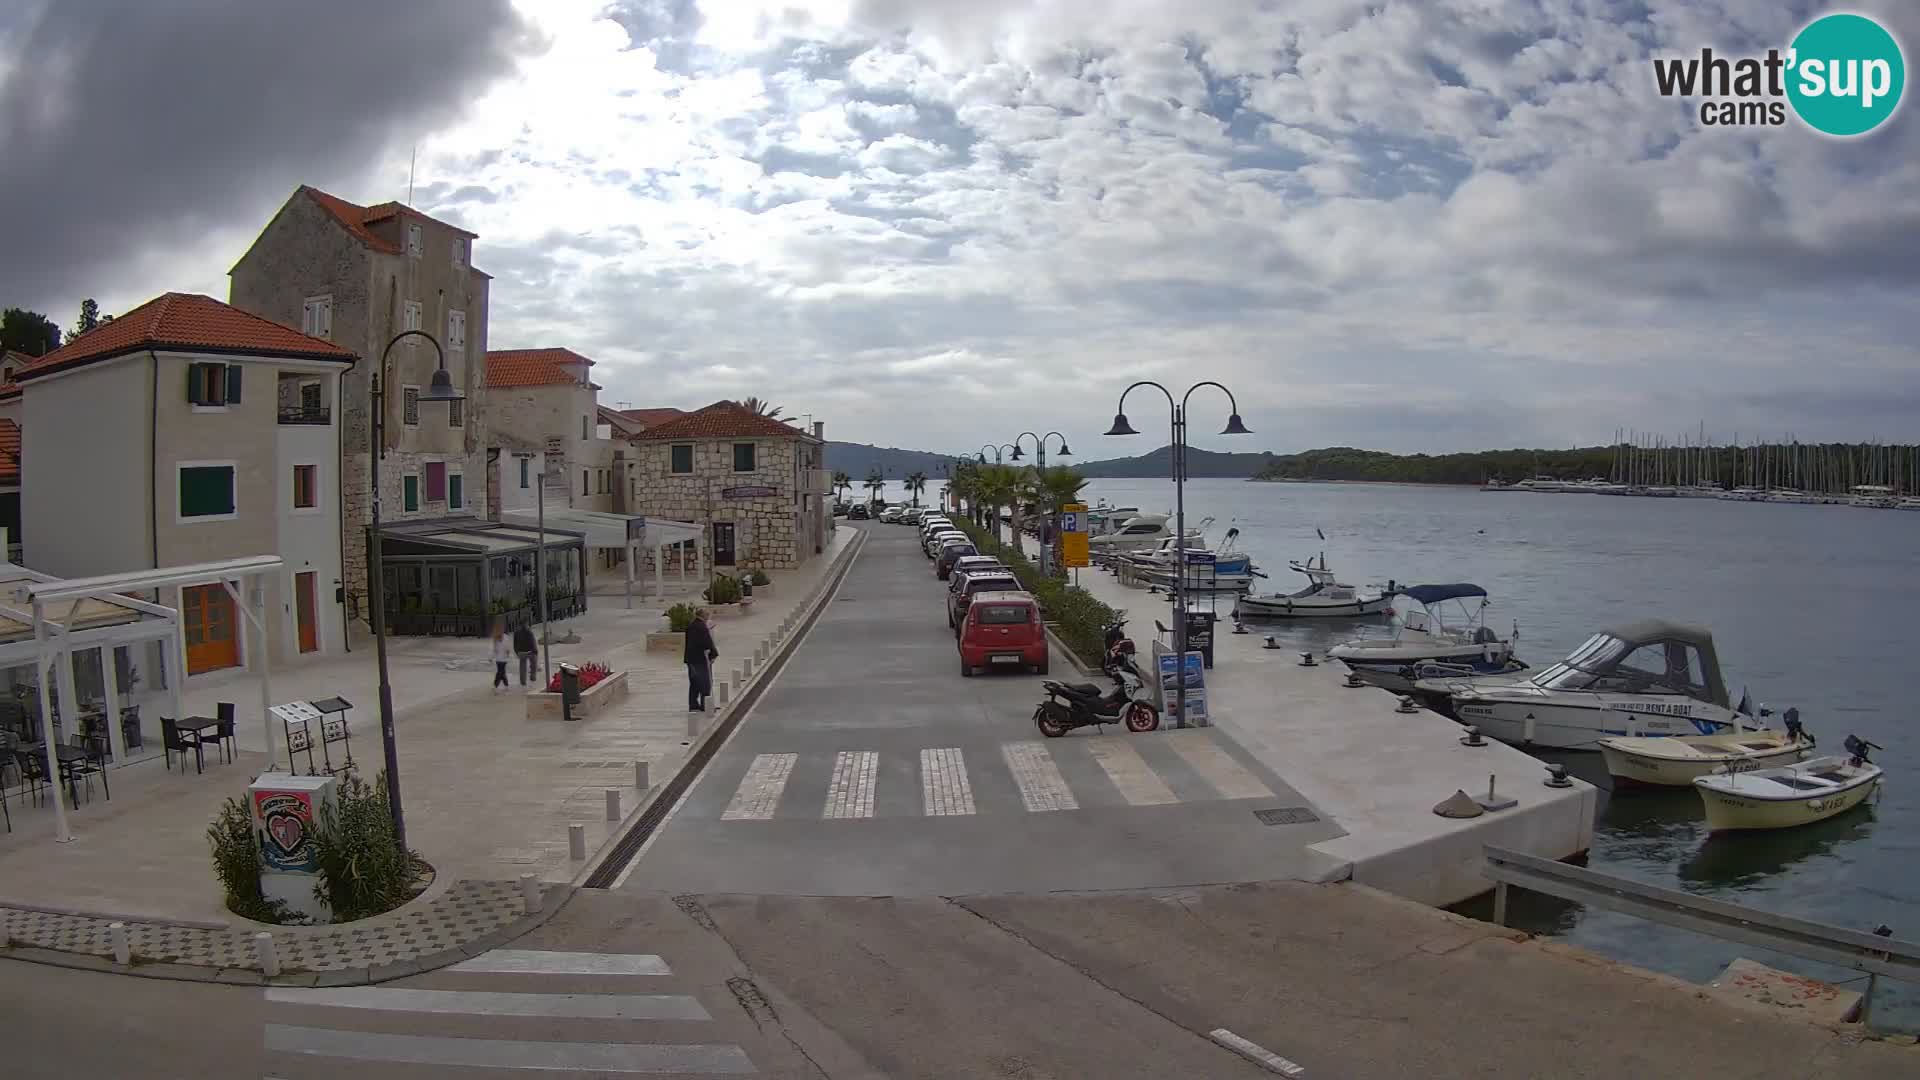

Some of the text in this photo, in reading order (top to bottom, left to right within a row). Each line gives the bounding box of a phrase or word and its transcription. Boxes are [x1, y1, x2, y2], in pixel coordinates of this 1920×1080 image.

[1064, 514, 1076, 530] P
[1646, 704, 1666, 713] RENT
[1666, 704, 1673, 714] A
[1673, 704, 1692, 716] BOAT
